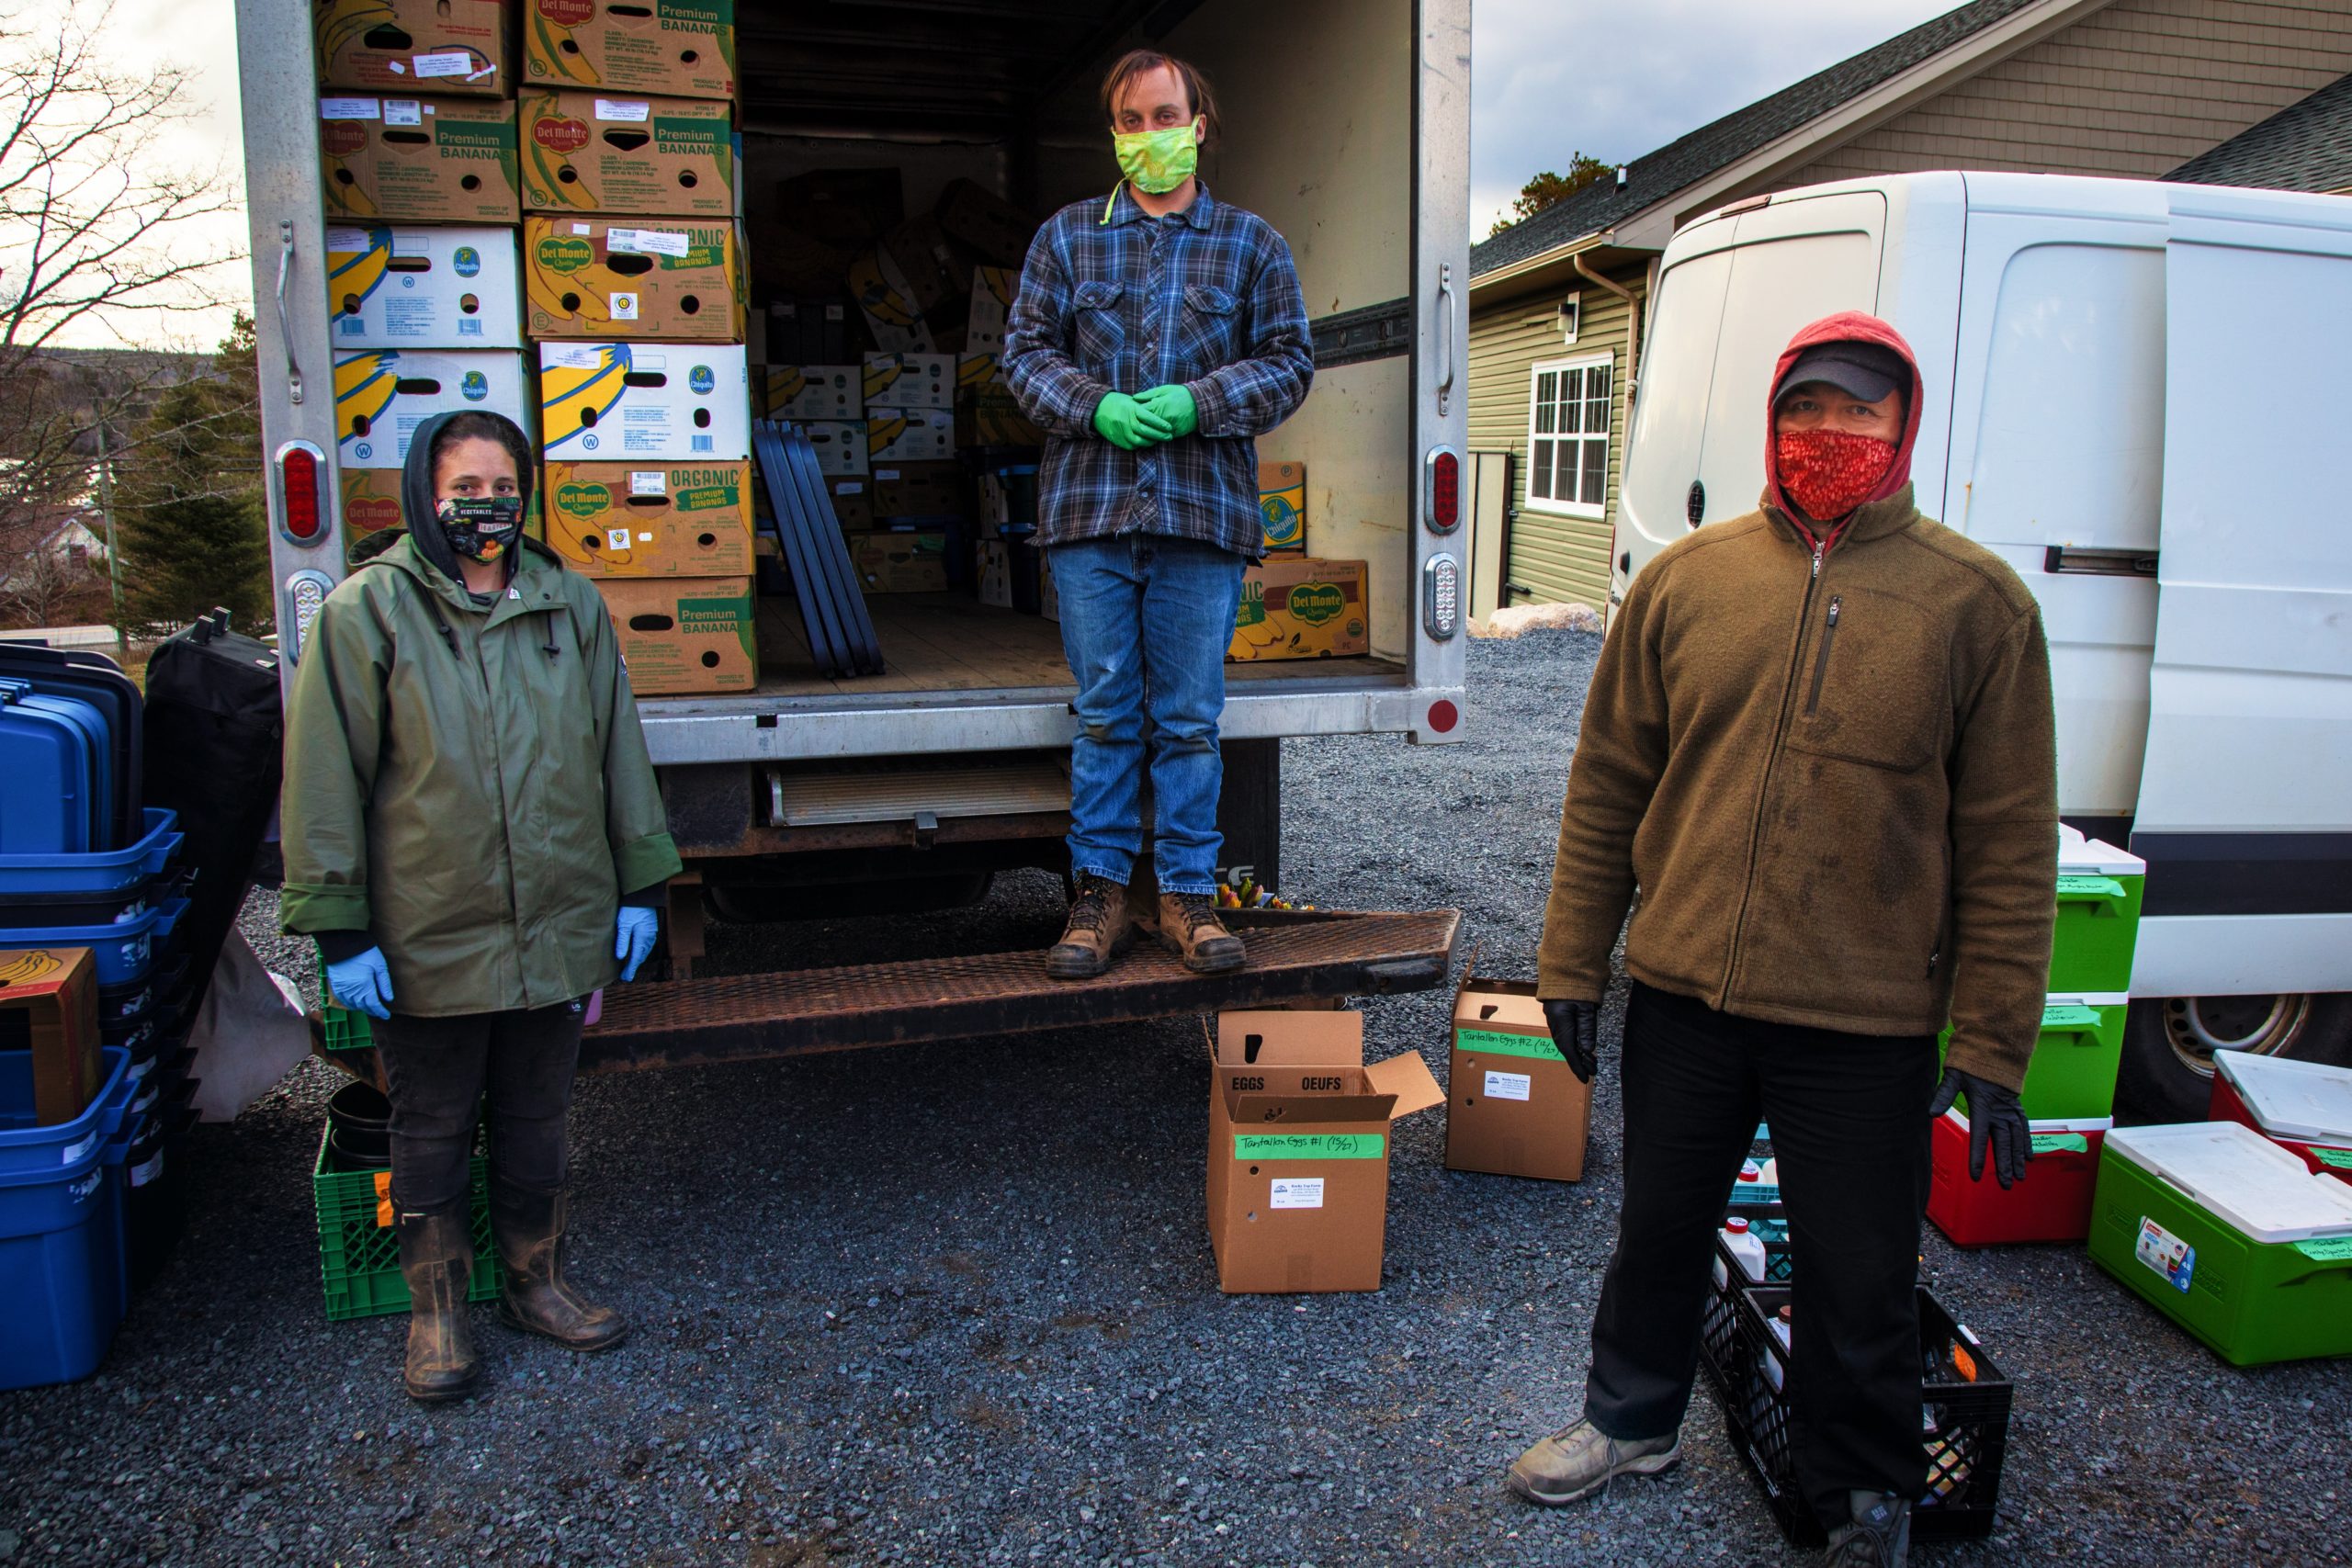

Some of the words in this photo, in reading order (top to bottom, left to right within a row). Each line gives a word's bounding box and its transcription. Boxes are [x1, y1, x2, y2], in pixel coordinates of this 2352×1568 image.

[541, 0, 557, 10] Del
[558, 0, 591, 14] Monte
[662, 5, 718, 20] Premium
[662, 20, 729, 36] BANANAS
[334, 130, 365, 141] Monte
[440, 132, 500, 145] Premium
[537, 127, 553, 136] Del
[555, 127, 587, 139] Monte
[659, 129, 714, 141] Premium
[440, 148, 511, 161] BANANAS
[659, 143, 725, 156] BANANAS
[541, 248, 557, 258] Del
[558, 248, 589, 260] Monte
[455, 263, 480, 273] Chiquita
[674, 257, 712, 268] BANANAS
[690, 380, 713, 390] Chiquita
[463, 386, 487, 397] Chiquita
[672, 469, 739, 487] ORGANIC
[560, 492, 575, 502] Del
[576, 492, 607, 503] Monte
[690, 490, 725, 500] PREMIUM
[691, 498, 727, 508] BANANAS
[349, 507, 366, 518] Del
[368, 507, 399, 518] Monte
[1266, 513, 1297, 537] Chiquita
[1294, 596, 1309, 607] Del
[1310, 595, 1341, 607] Monte
[682, 609, 736, 620] Premium
[1462, 1031, 1498, 1043] Tantallon
[1499, 1035, 1517, 1047] Eggs
[1518, 1037, 1532, 1047] #2
[1232, 1077, 1264, 1090] EGGS
[1302, 1077, 1341, 1090] OEUFS
[1241, 1137, 1285, 1149] Tantallon
[1286, 1136, 1307, 1147] Eggs
[1310, 1136, 1322, 1146] #1
[1327, 1135, 1358, 1154] (15/27)
